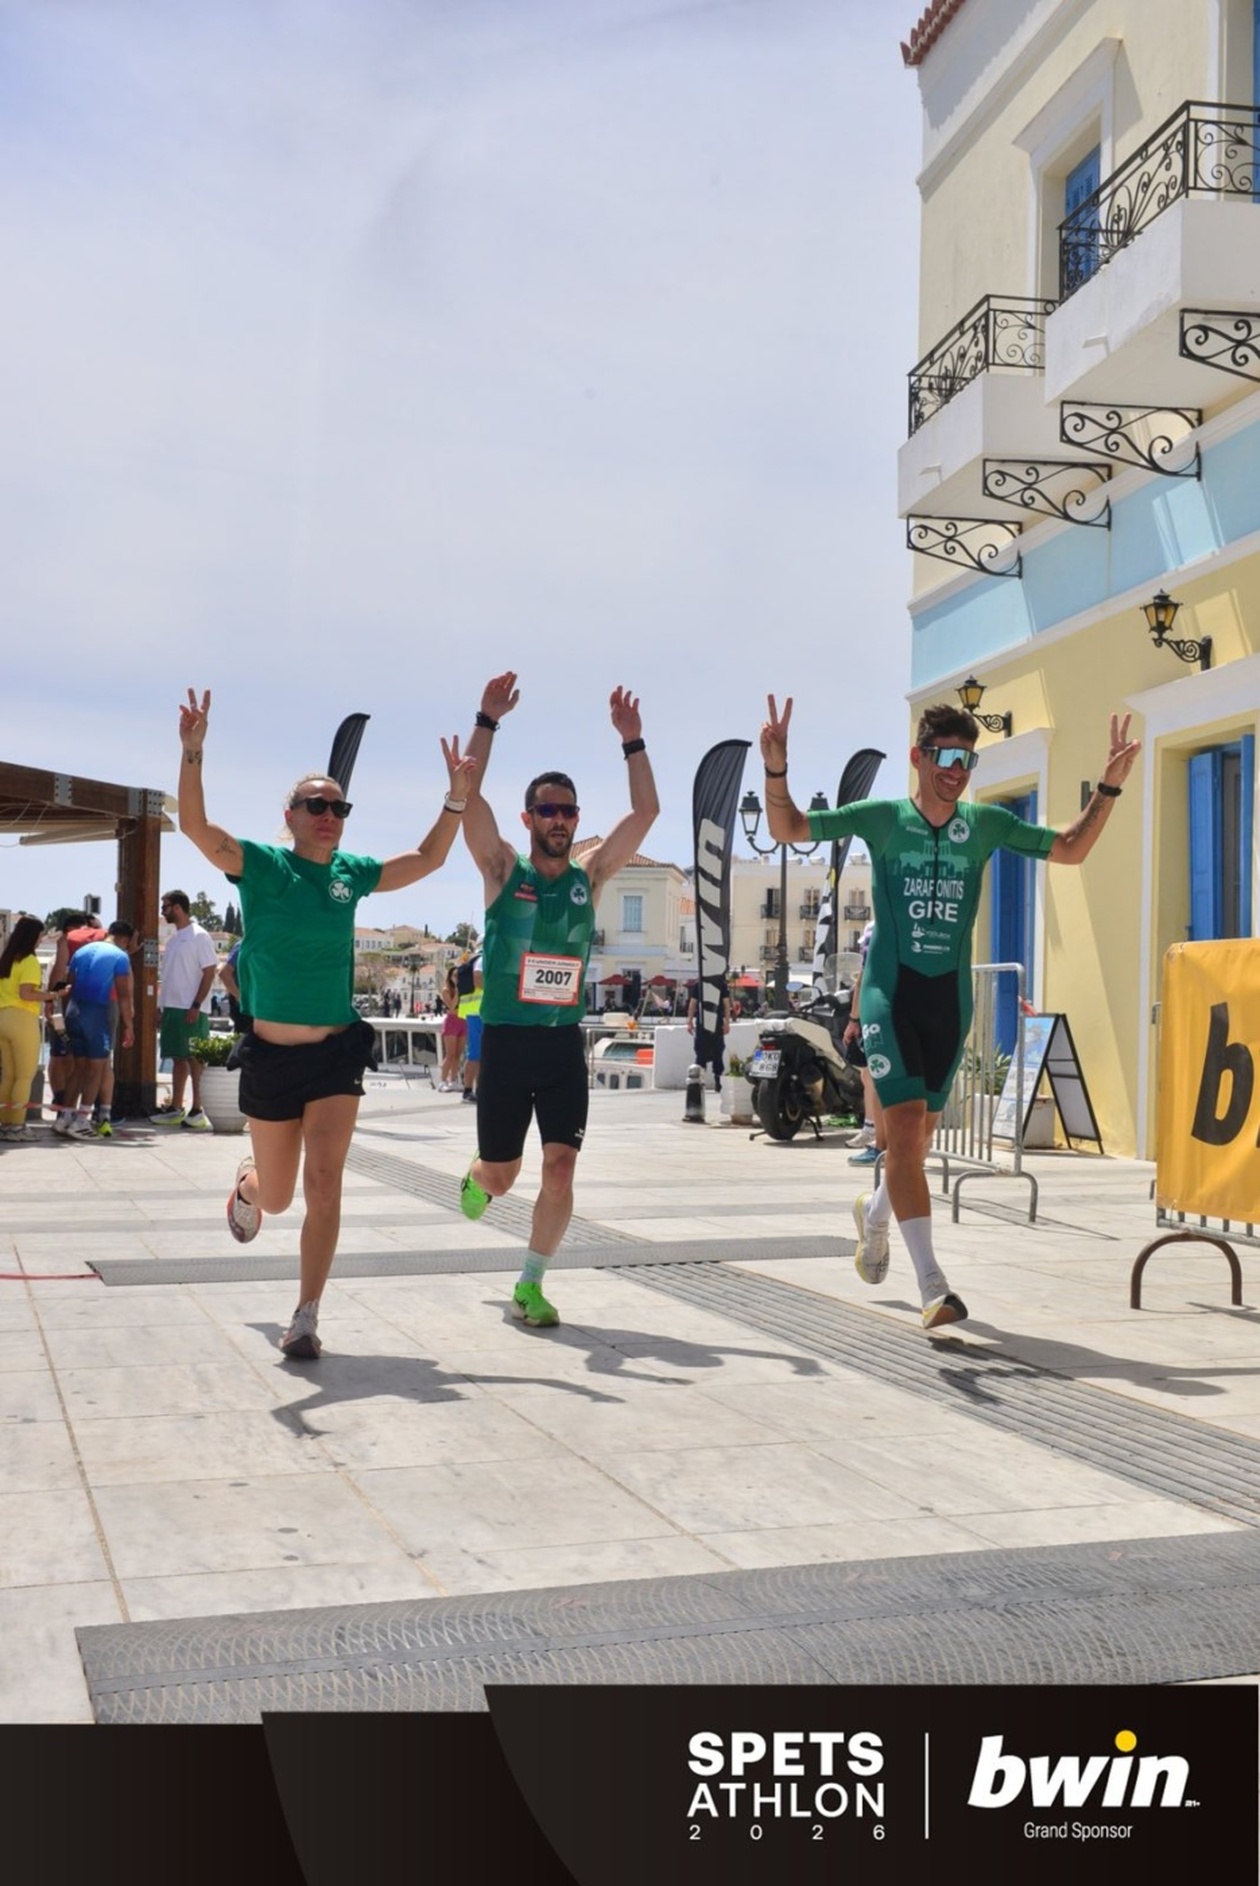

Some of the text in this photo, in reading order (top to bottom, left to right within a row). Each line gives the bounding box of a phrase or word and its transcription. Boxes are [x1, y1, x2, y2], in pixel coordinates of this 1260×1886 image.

[908, 900, 959, 923] GRE
[535, 969, 572, 986] 2007
[1191, 1002, 1260, 1148] b
